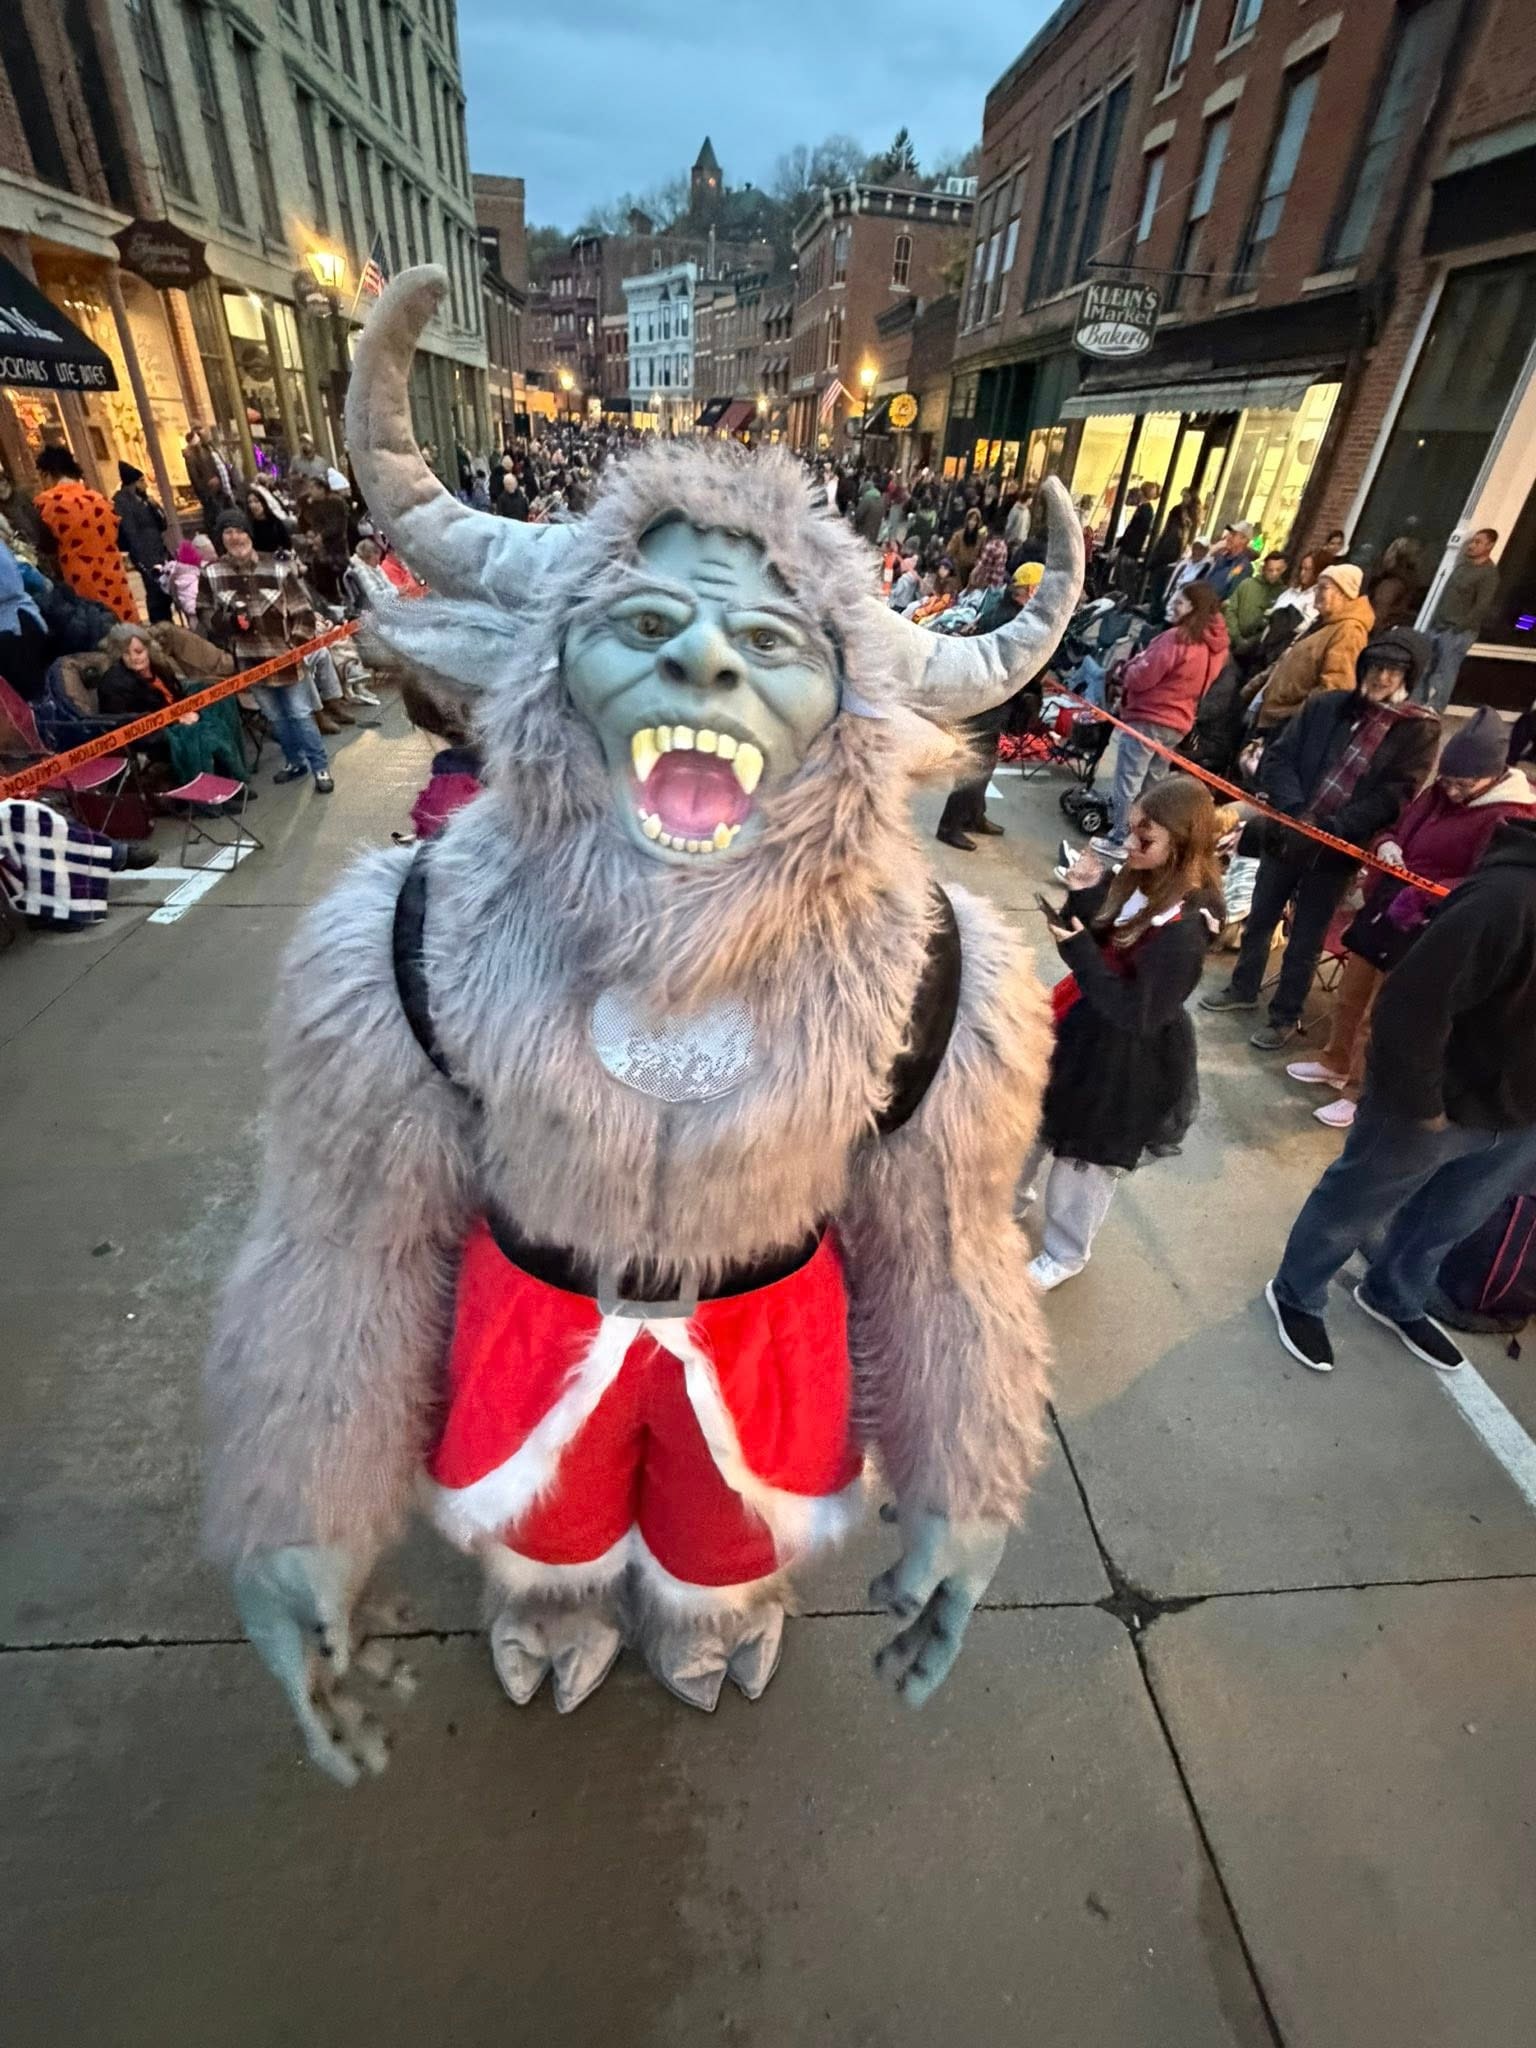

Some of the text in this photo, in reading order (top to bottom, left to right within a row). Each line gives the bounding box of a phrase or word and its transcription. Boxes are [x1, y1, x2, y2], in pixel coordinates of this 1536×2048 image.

[1083, 285, 1158, 319] KLEIN'S
[1090, 304, 1153, 326] Market
[1083, 323, 1148, 350] Bakery
[170, 695, 205, 719] CAUTION
[123, 712, 165, 740] CAUTION
[68, 735, 118, 766] CAUTION
[3, 760, 62, 796] CAUTION
